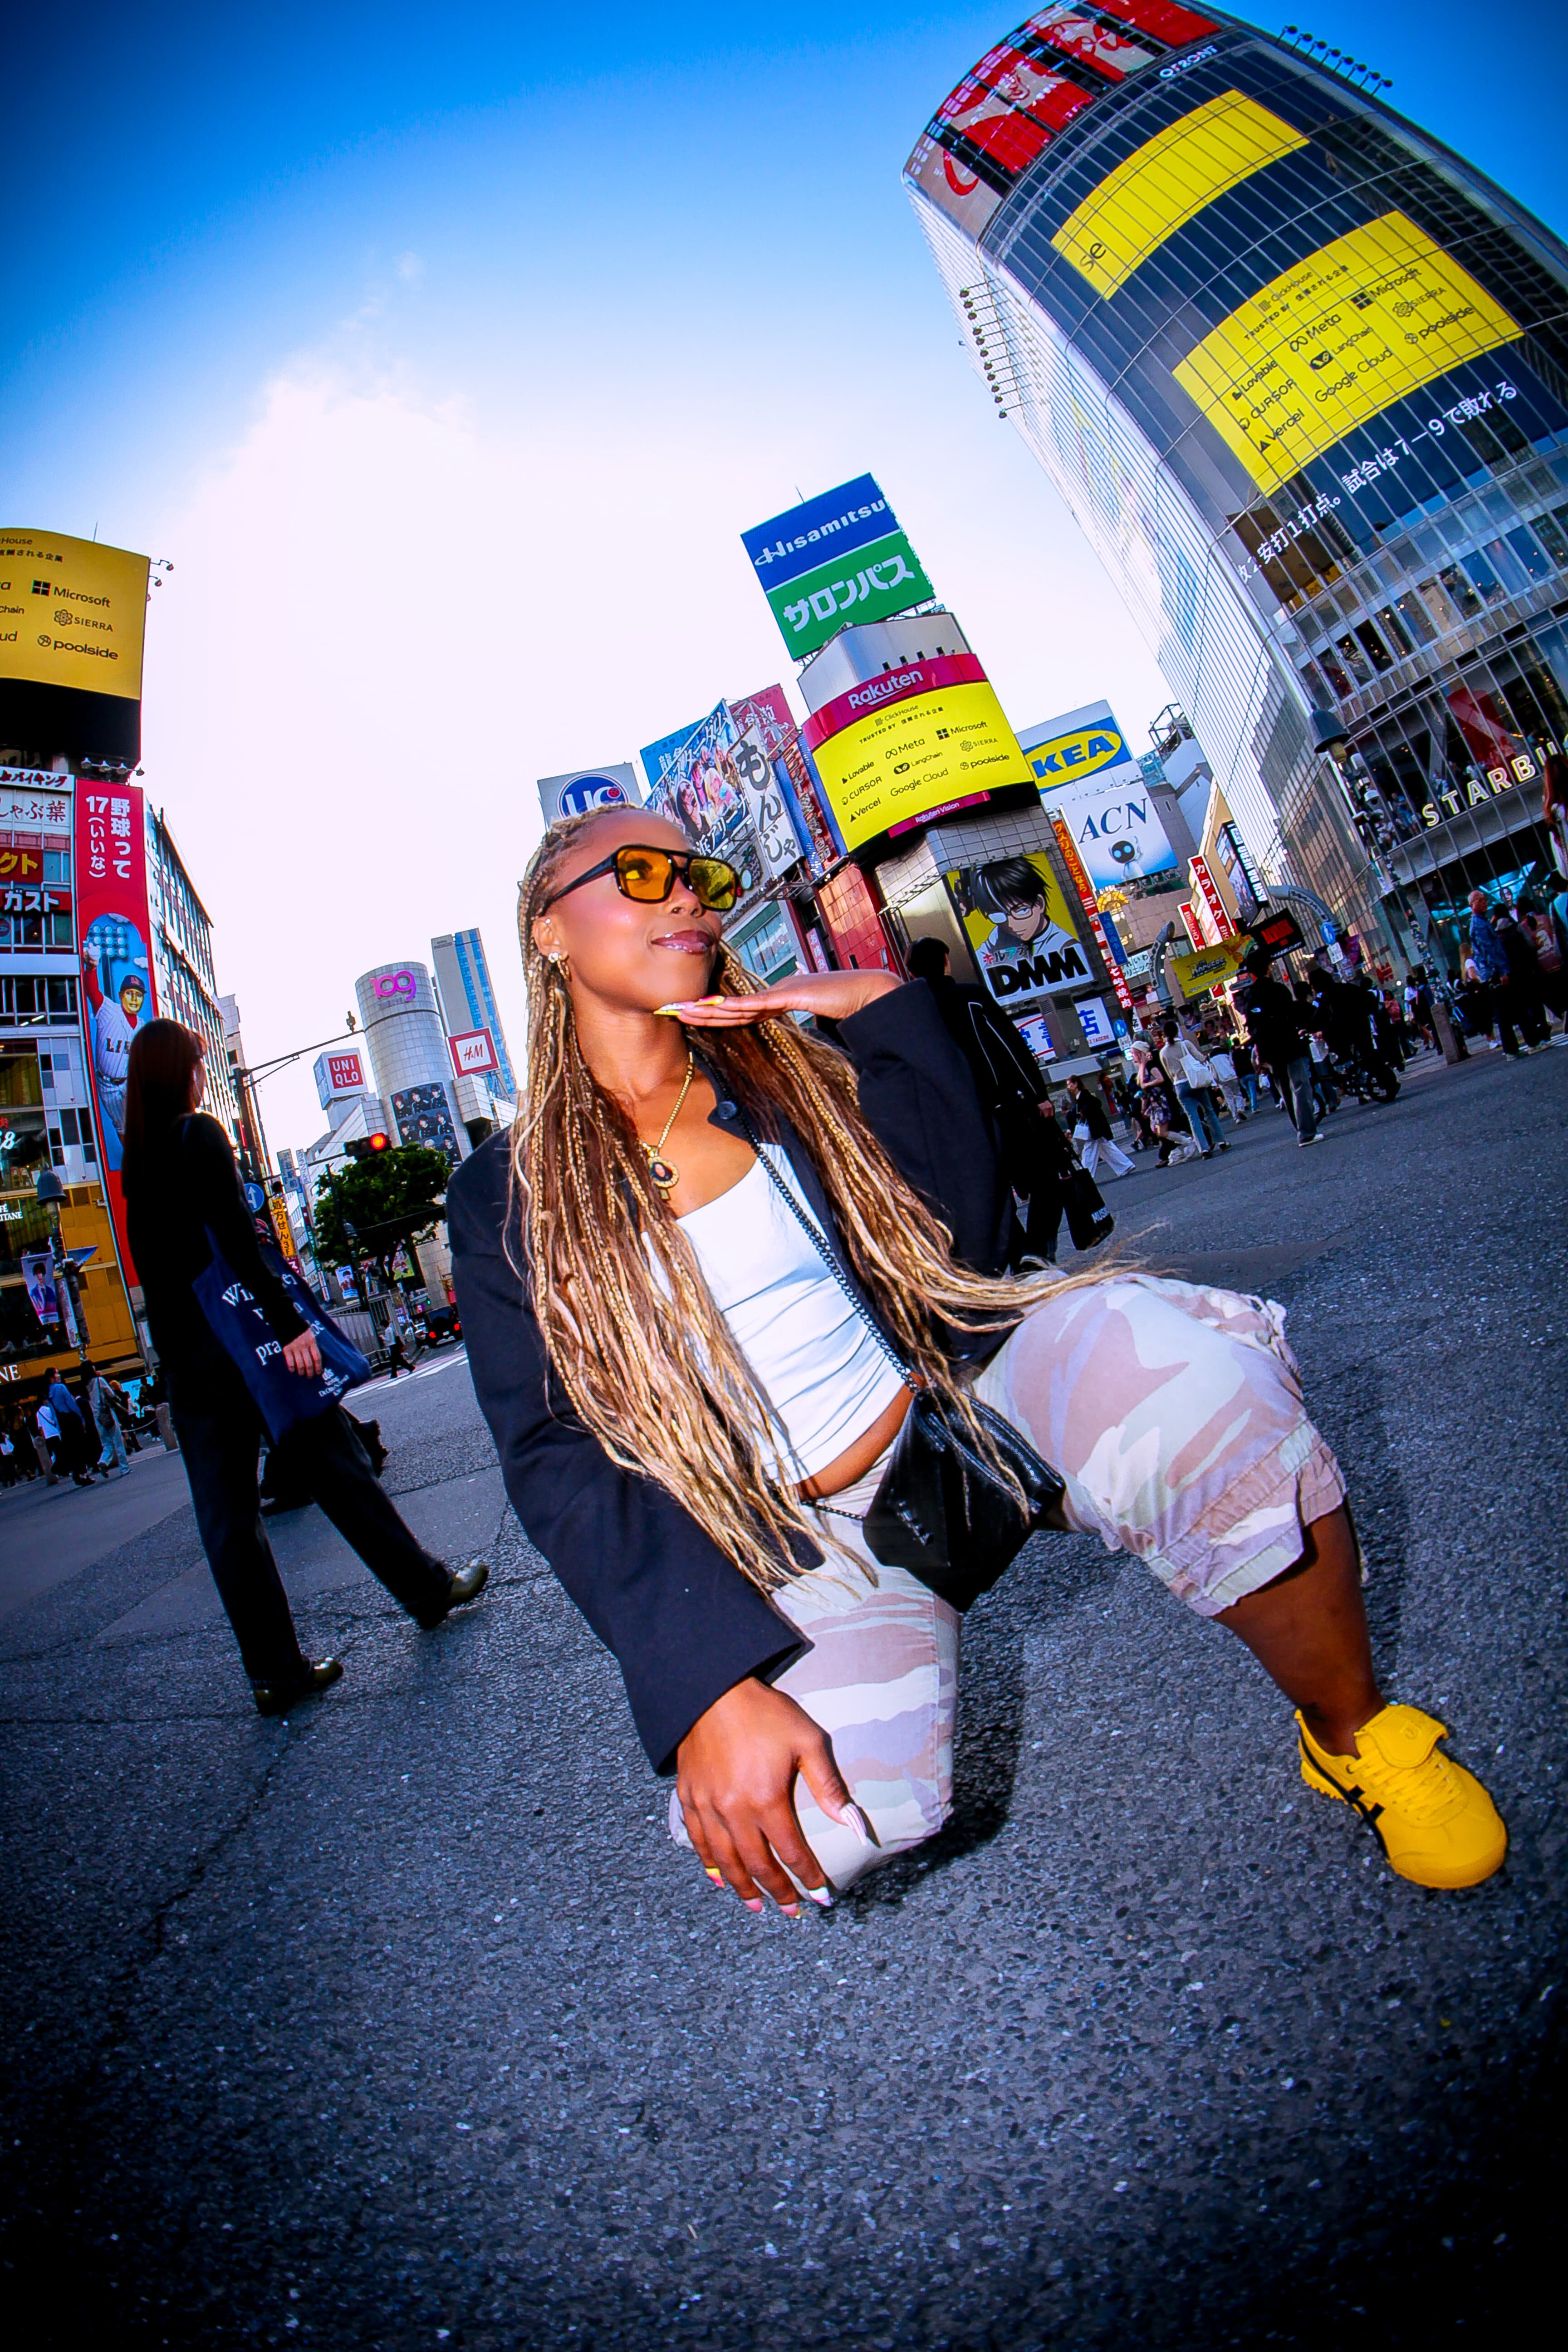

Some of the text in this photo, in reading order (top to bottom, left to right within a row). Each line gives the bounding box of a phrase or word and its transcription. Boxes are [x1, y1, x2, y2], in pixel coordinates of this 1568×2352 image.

[1160, 45, 1218, 78] QFRONT
[1271, 271, 1313, 302] ClickHouse
[1370, 267, 1422, 299] Microsoft
[1410, 286, 1447, 308] SIERRA
[1244, 311, 1280, 340] TRUSTED
[1305, 313, 1342, 339] Meta
[1418, 306, 1475, 340] poolside
[1332, 325, 1373, 355] LangChain
[1240, 360, 1279, 392] Lovable
[1314, 346, 1393, 402] Google Cloud
[1250, 378, 1297, 419] CURSOR
[1265, 407, 1305, 441] Vercel
[755, 499, 886, 566] Hisamitsu
[54, 587, 111, 608] Microsoft
[783, 554, 916, 632] サロンパス
[74, 617, 113, 632] SIERRA
[53, 638, 118, 660] poolside
[848, 669, 924, 710] Rakuten
[884, 705, 919, 722] ClickHouse
[950, 720, 988, 735] Microsoft
[859, 728, 887, 744] TRUSTED
[898, 738, 926, 754] Meta
[973, 737, 998, 747] SIERRA
[848, 761, 875, 780] Lovable
[911, 751, 943, 767] LangChain
[970, 753, 1010, 769] poolside
[849, 776, 882, 800] CURSOR
[890, 767, 949, 797] Google Cloud
[735, 740, 797, 863] もんじゃ
[854, 797, 881, 817] Vercel
[915, 801, 960, 823] Rakuten Vision
[1078, 797, 1148, 844] ACN
[111, 797, 131, 878] 野球って
[1237, 845, 1269, 902] ASH DA HERO
[4, 889, 59, 912] ガスト
[1195, 864, 1223, 920] カラオケ
[369, 970, 417, 1001] 109
[986, 947, 1088, 998] DMM
[332, 1058, 355, 1073] UNI
[463, 1044, 484, 1061] H&M
[335, 1073, 359, 1086] QLO
